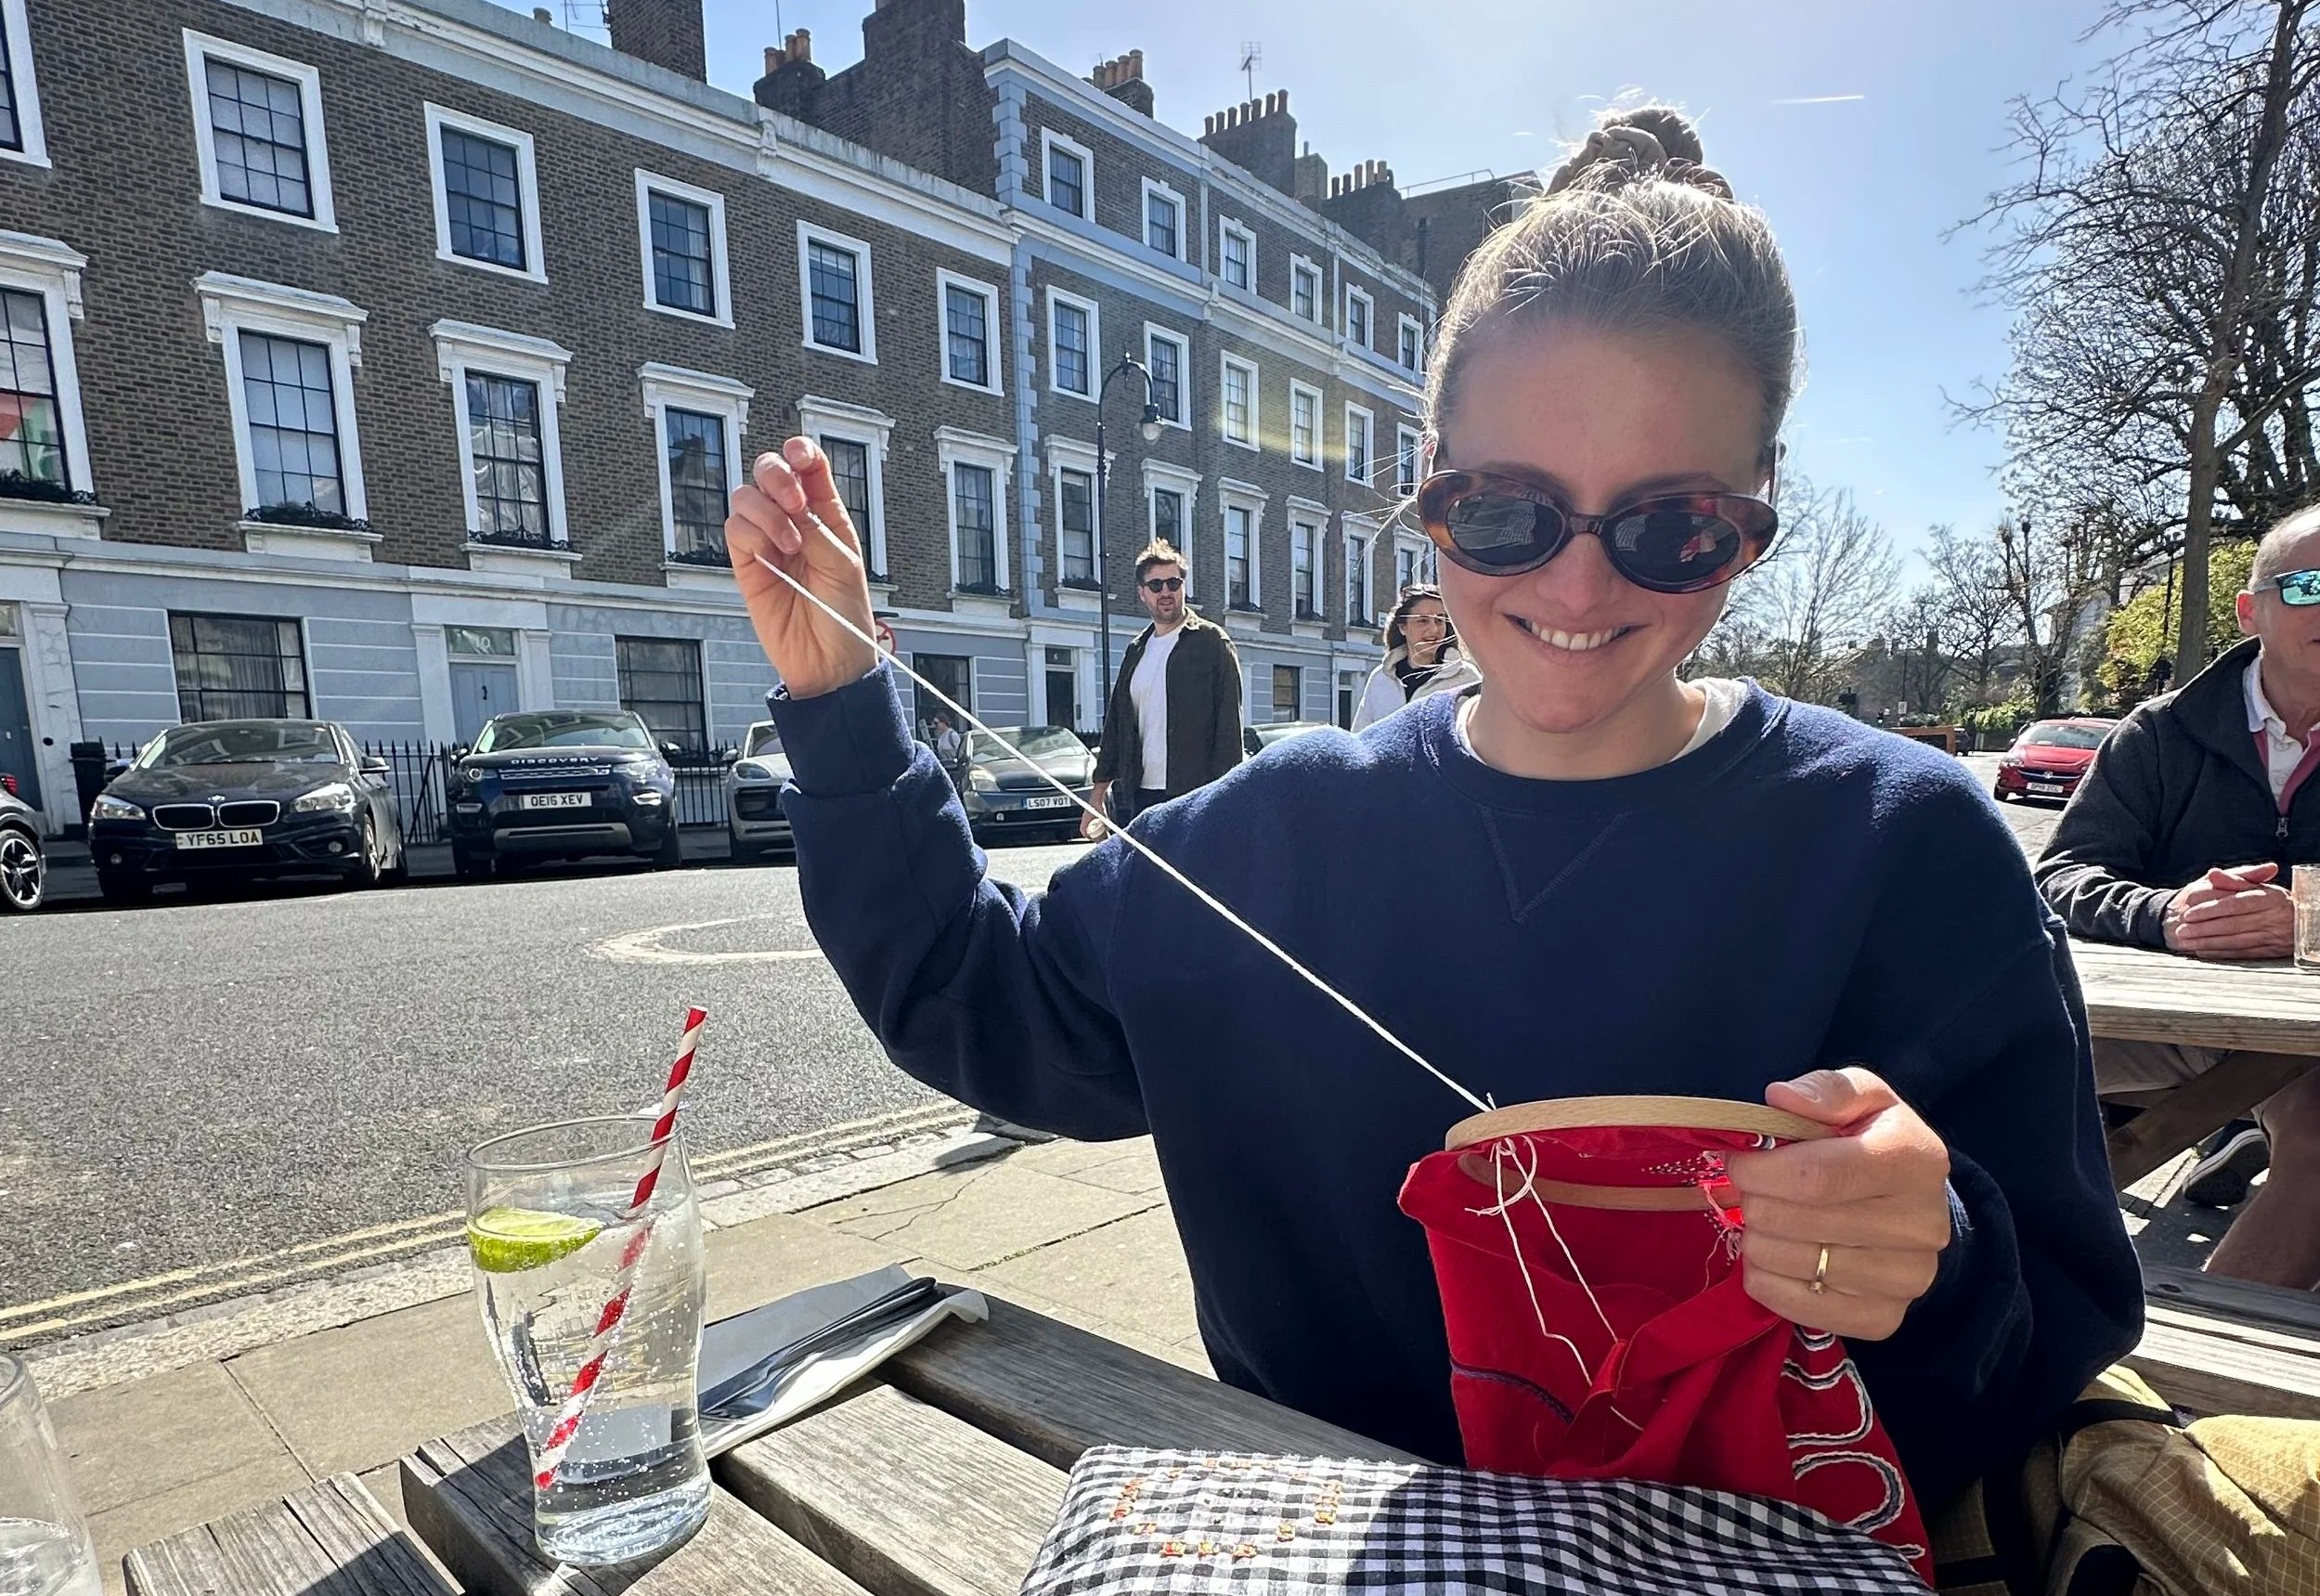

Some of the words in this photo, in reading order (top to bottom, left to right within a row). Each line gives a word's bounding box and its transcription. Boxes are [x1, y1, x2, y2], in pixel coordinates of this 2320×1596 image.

[561, 794, 583, 806] XEV
[1028, 798, 1051, 808] LS07
[187, 833, 226, 846] YF65
[229, 831, 260, 844] LOA
